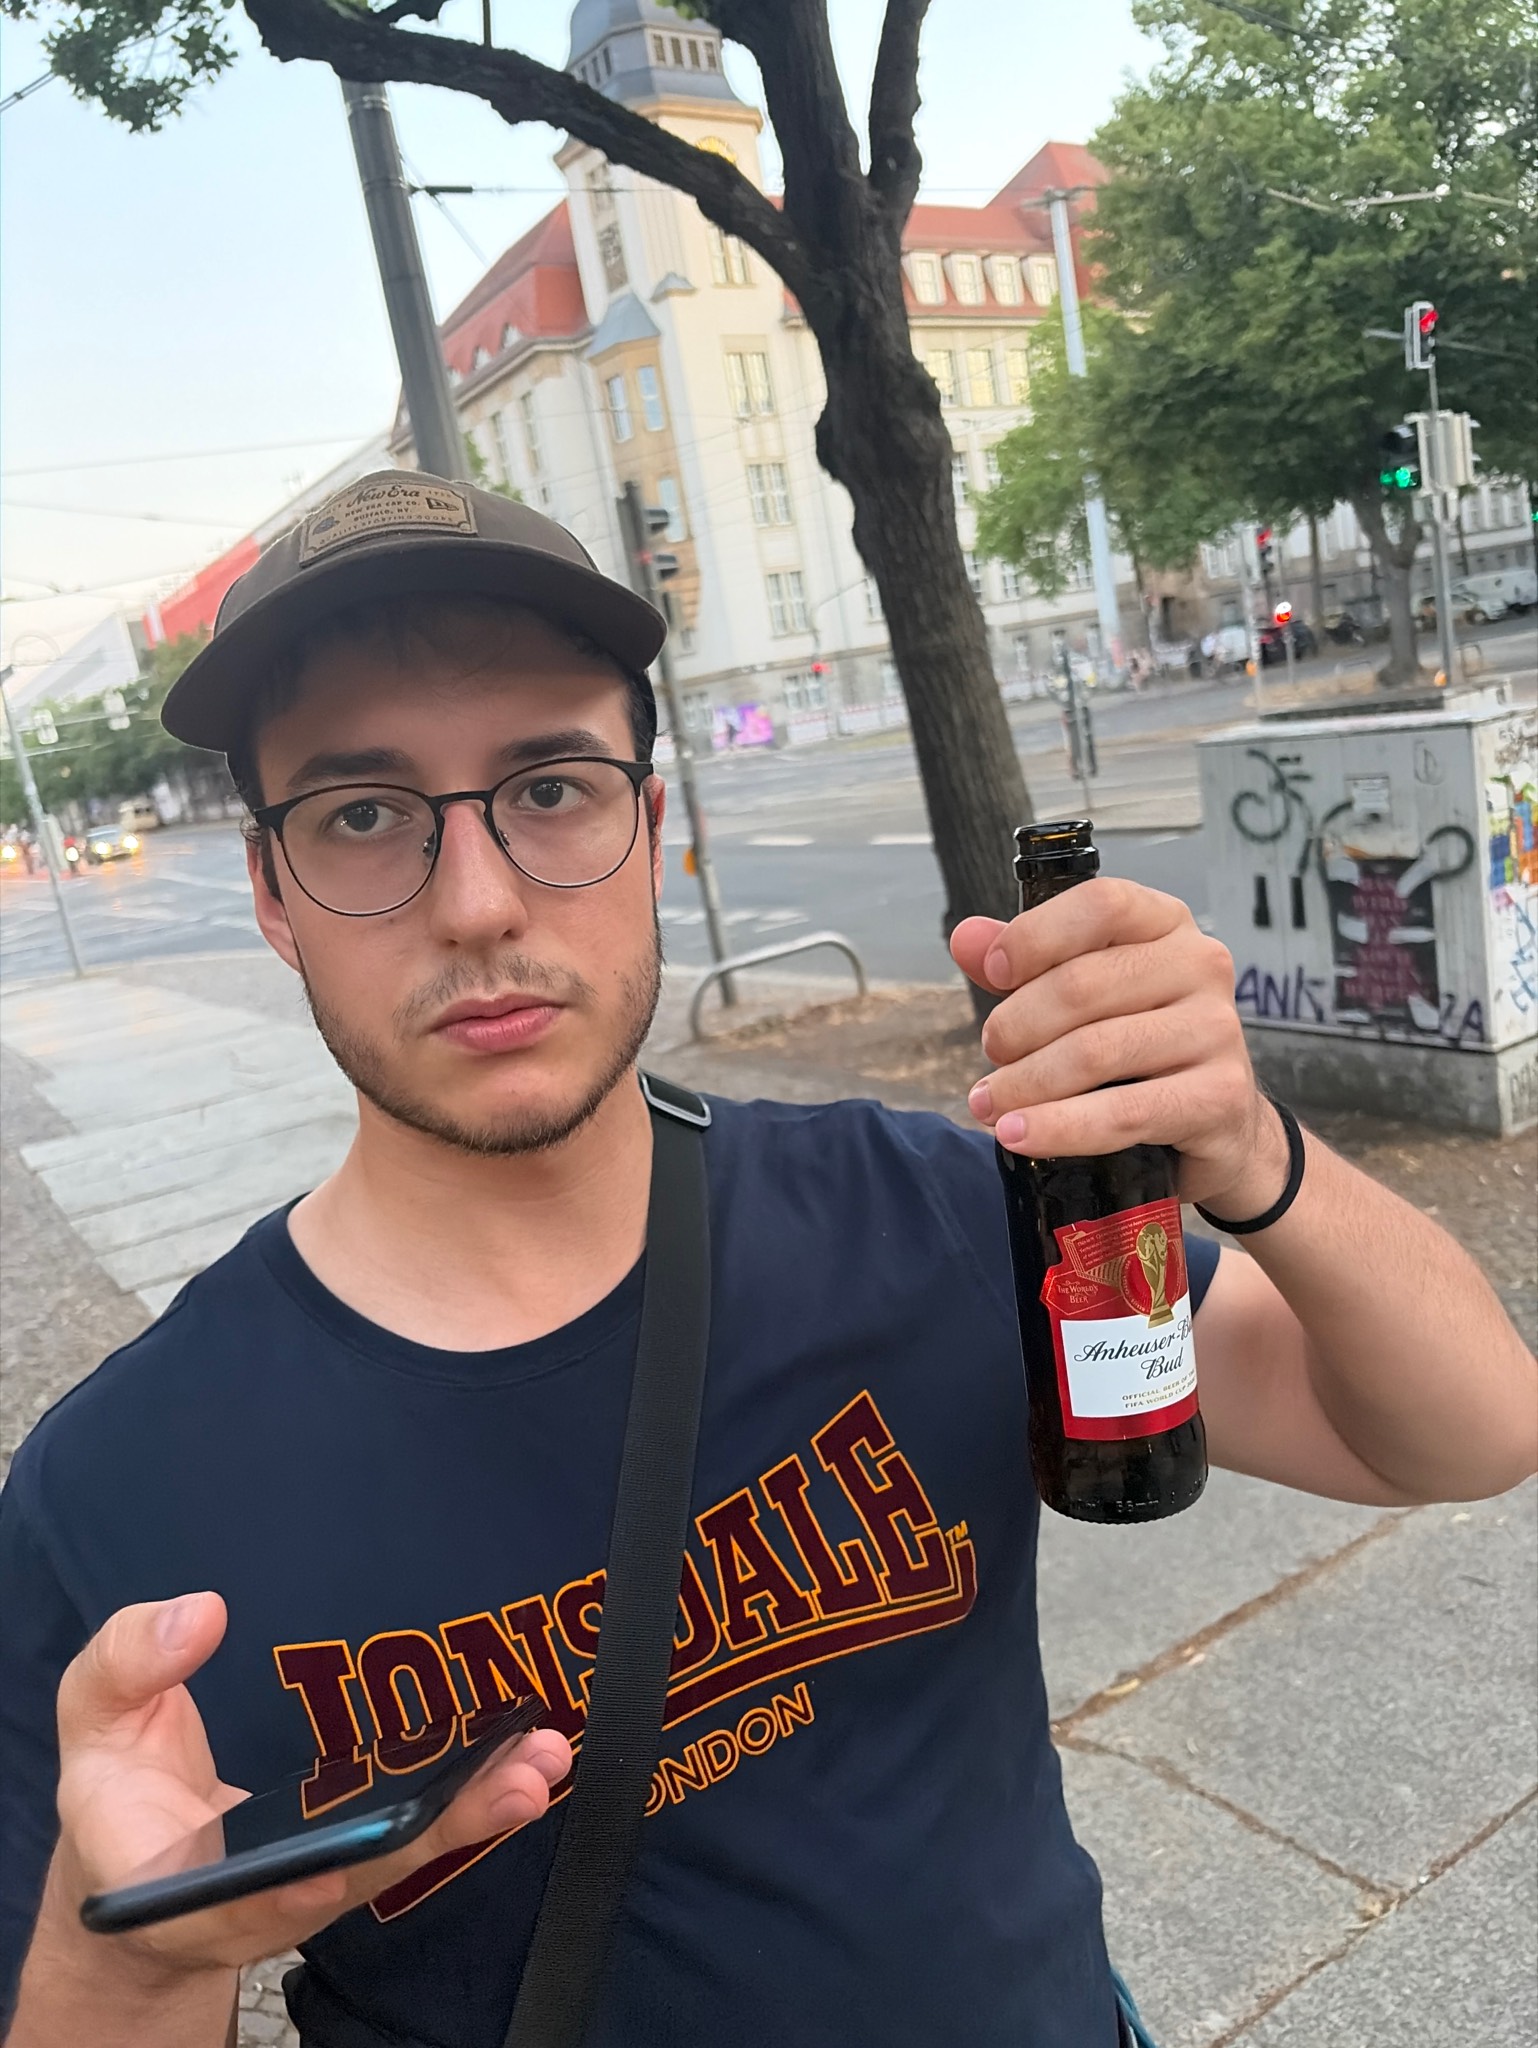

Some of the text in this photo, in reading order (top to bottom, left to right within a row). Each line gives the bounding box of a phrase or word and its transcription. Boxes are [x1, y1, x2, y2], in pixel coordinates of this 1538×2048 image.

[346, 486, 386, 508] New
[387, 484, 420, 498] Era
[345, 507, 363, 518] NEW
[365, 503, 382, 511] ERA
[1070, 1294, 1089, 1304] BEER
[1140, 1346, 1184, 1380] Bud
[1121, 1389, 1160, 1402] OFFICIAL
[1162, 1381, 1180, 1392] BEER
[1180, 1376, 1188, 1386] OF
[1124, 1400, 1144, 1409] FIFA
[1145, 1393, 1174, 1405] WORLD
[1175, 1385, 1186, 1396] CUP
[643, 1681, 816, 1817] NDON
